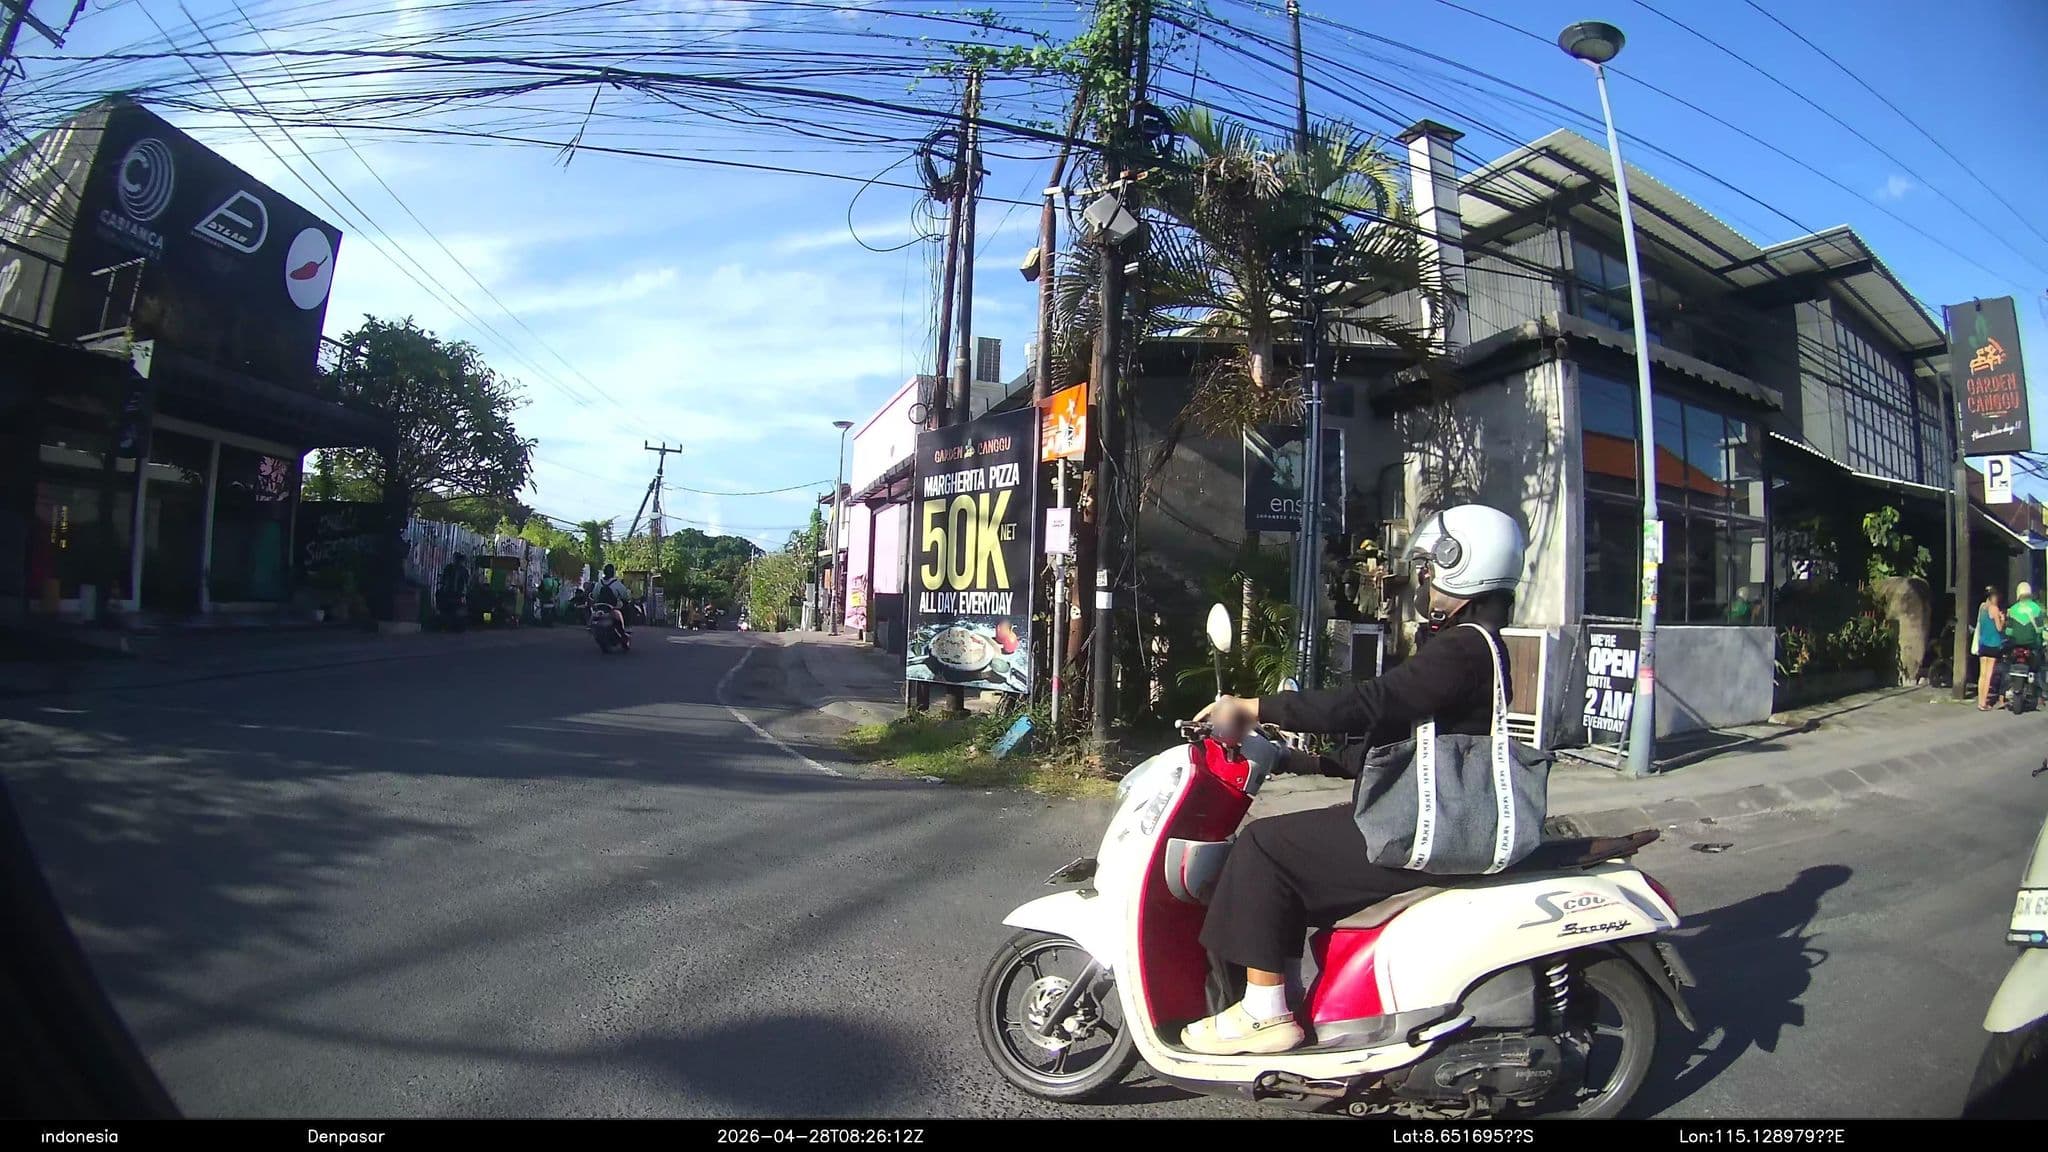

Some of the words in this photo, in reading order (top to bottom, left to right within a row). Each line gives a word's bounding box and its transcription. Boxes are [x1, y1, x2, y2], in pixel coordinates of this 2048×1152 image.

[1967, 373, 2016, 394] GARDEN
[1968, 391, 2019, 413] CANGGU
[935, 446, 963, 463] GARDEN
[978, 436, 1011, 455] CANGGU
[924, 468, 985, 498] MARGHERITA
[988, 462, 1020, 489] PIZZA
[1989, 459, 2003, 488] P
[1270, 497, 1302, 513] ens
[920, 490, 1013, 591] 50K
[1000, 523, 1017, 541] NET
[919, 592, 937, 613] ALL
[937, 592, 957, 616] DAY,
[959, 592, 1014, 616] EVERYDAY
[1590, 633, 1616, 648] WE'RE
[1588, 646, 1636, 679] OPEN
[1587, 674, 1612, 689] UNTIL
[1584, 688, 1598, 715] 2
[1600, 690, 1632, 720] AM
[1583, 714, 1625, 734] EVERYDAY
